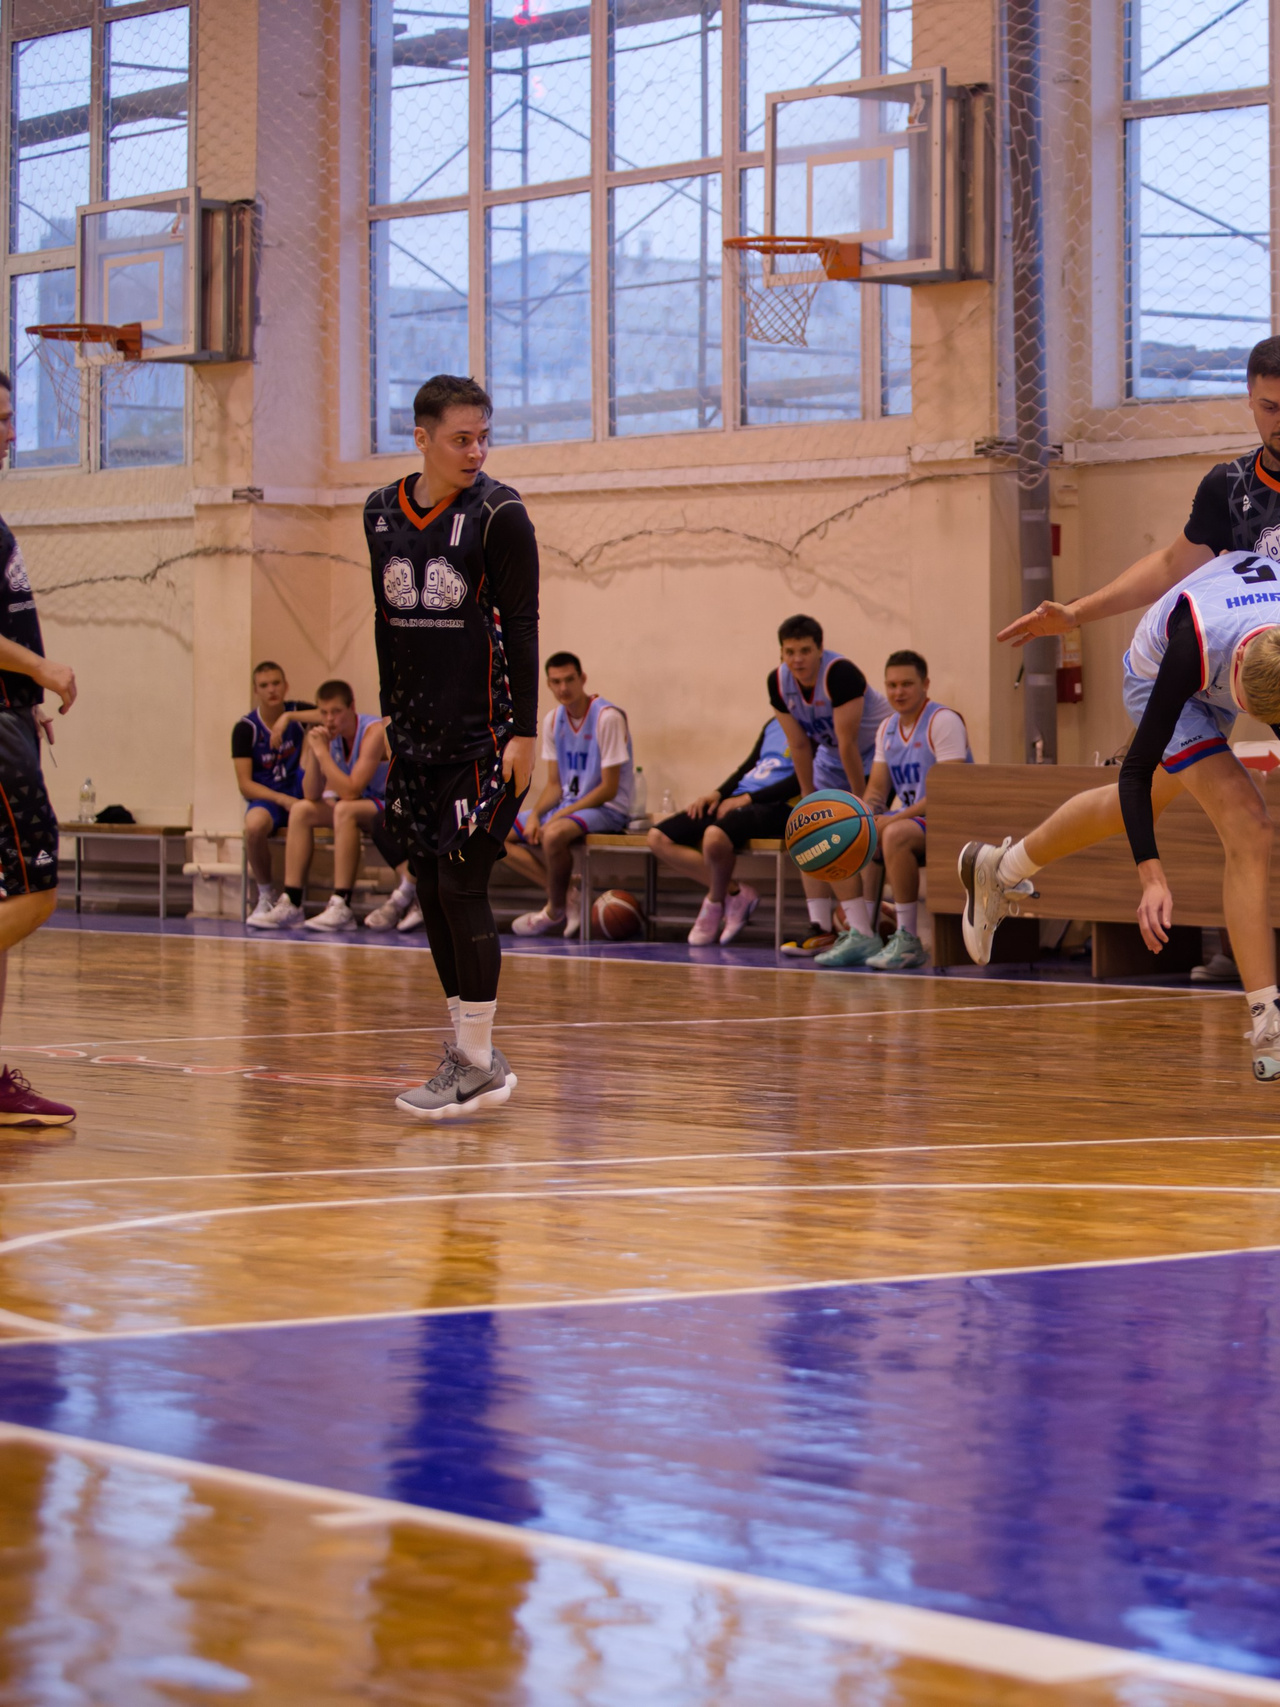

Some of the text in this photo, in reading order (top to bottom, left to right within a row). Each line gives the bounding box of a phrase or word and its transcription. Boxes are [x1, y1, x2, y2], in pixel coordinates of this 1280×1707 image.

[449, 513, 466, 547] 11
[1232, 556, 1278, 585] 5
[1181, 735, 1203, 747] MAXX
[569, 776, 580, 796] 4
[786, 808, 835, 839] Wilson
[795, 839, 831, 865] SIBUR
